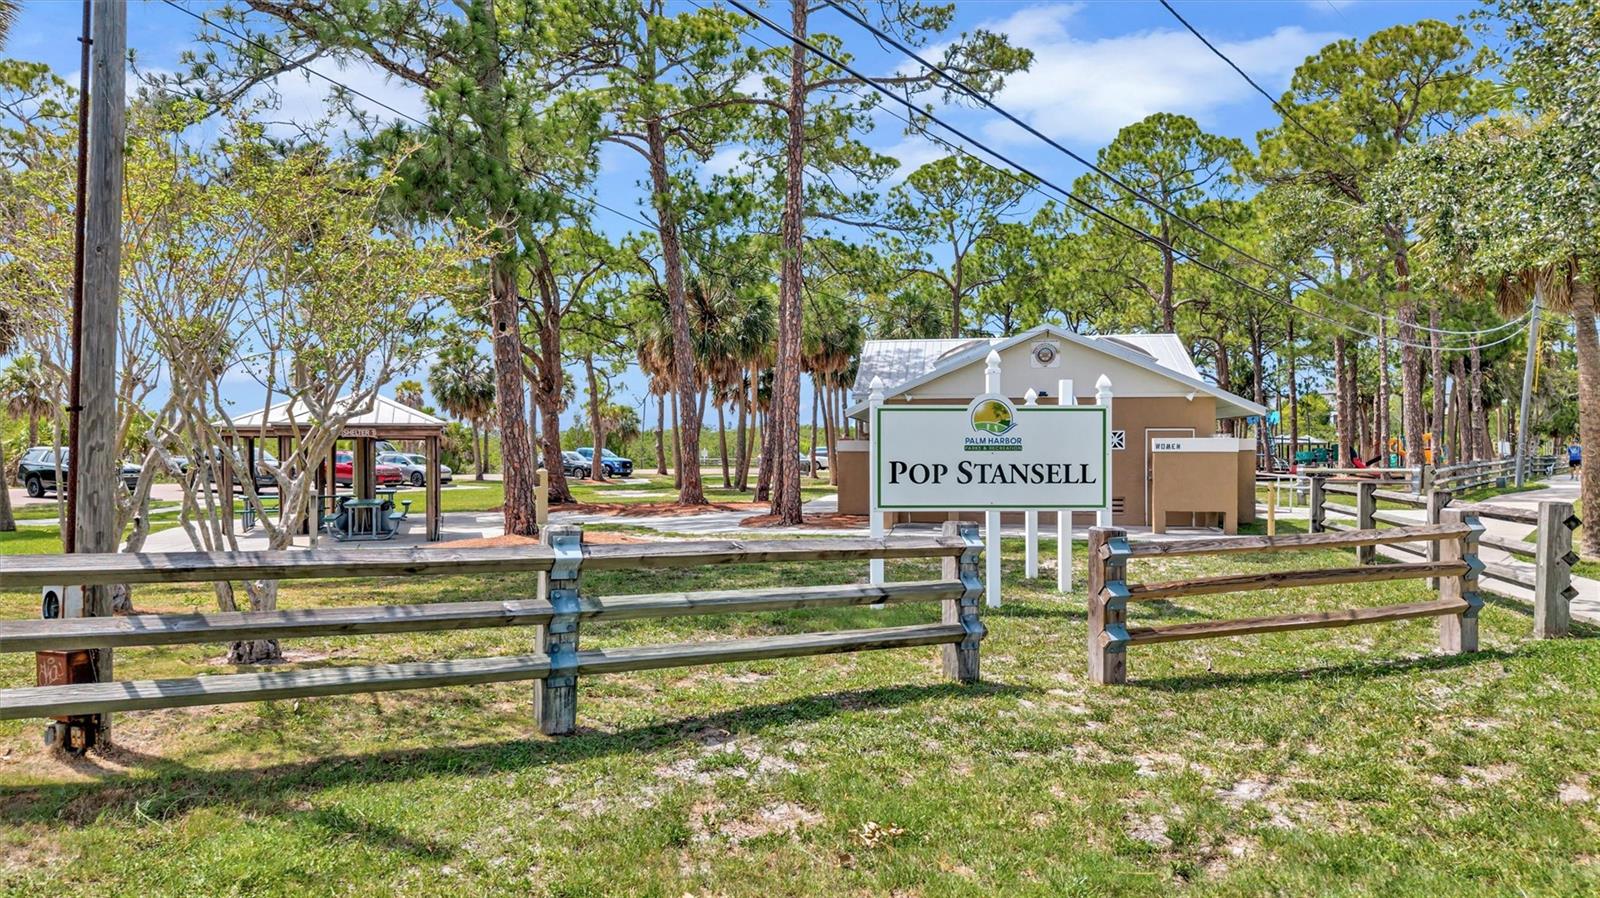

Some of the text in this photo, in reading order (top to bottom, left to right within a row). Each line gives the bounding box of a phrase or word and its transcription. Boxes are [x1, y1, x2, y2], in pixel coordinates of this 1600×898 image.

[343, 429, 370, 437] SHELTER
[964, 437, 1022, 445] PALM HARBOR
[889, 460, 1096, 485] POP STANSELL
